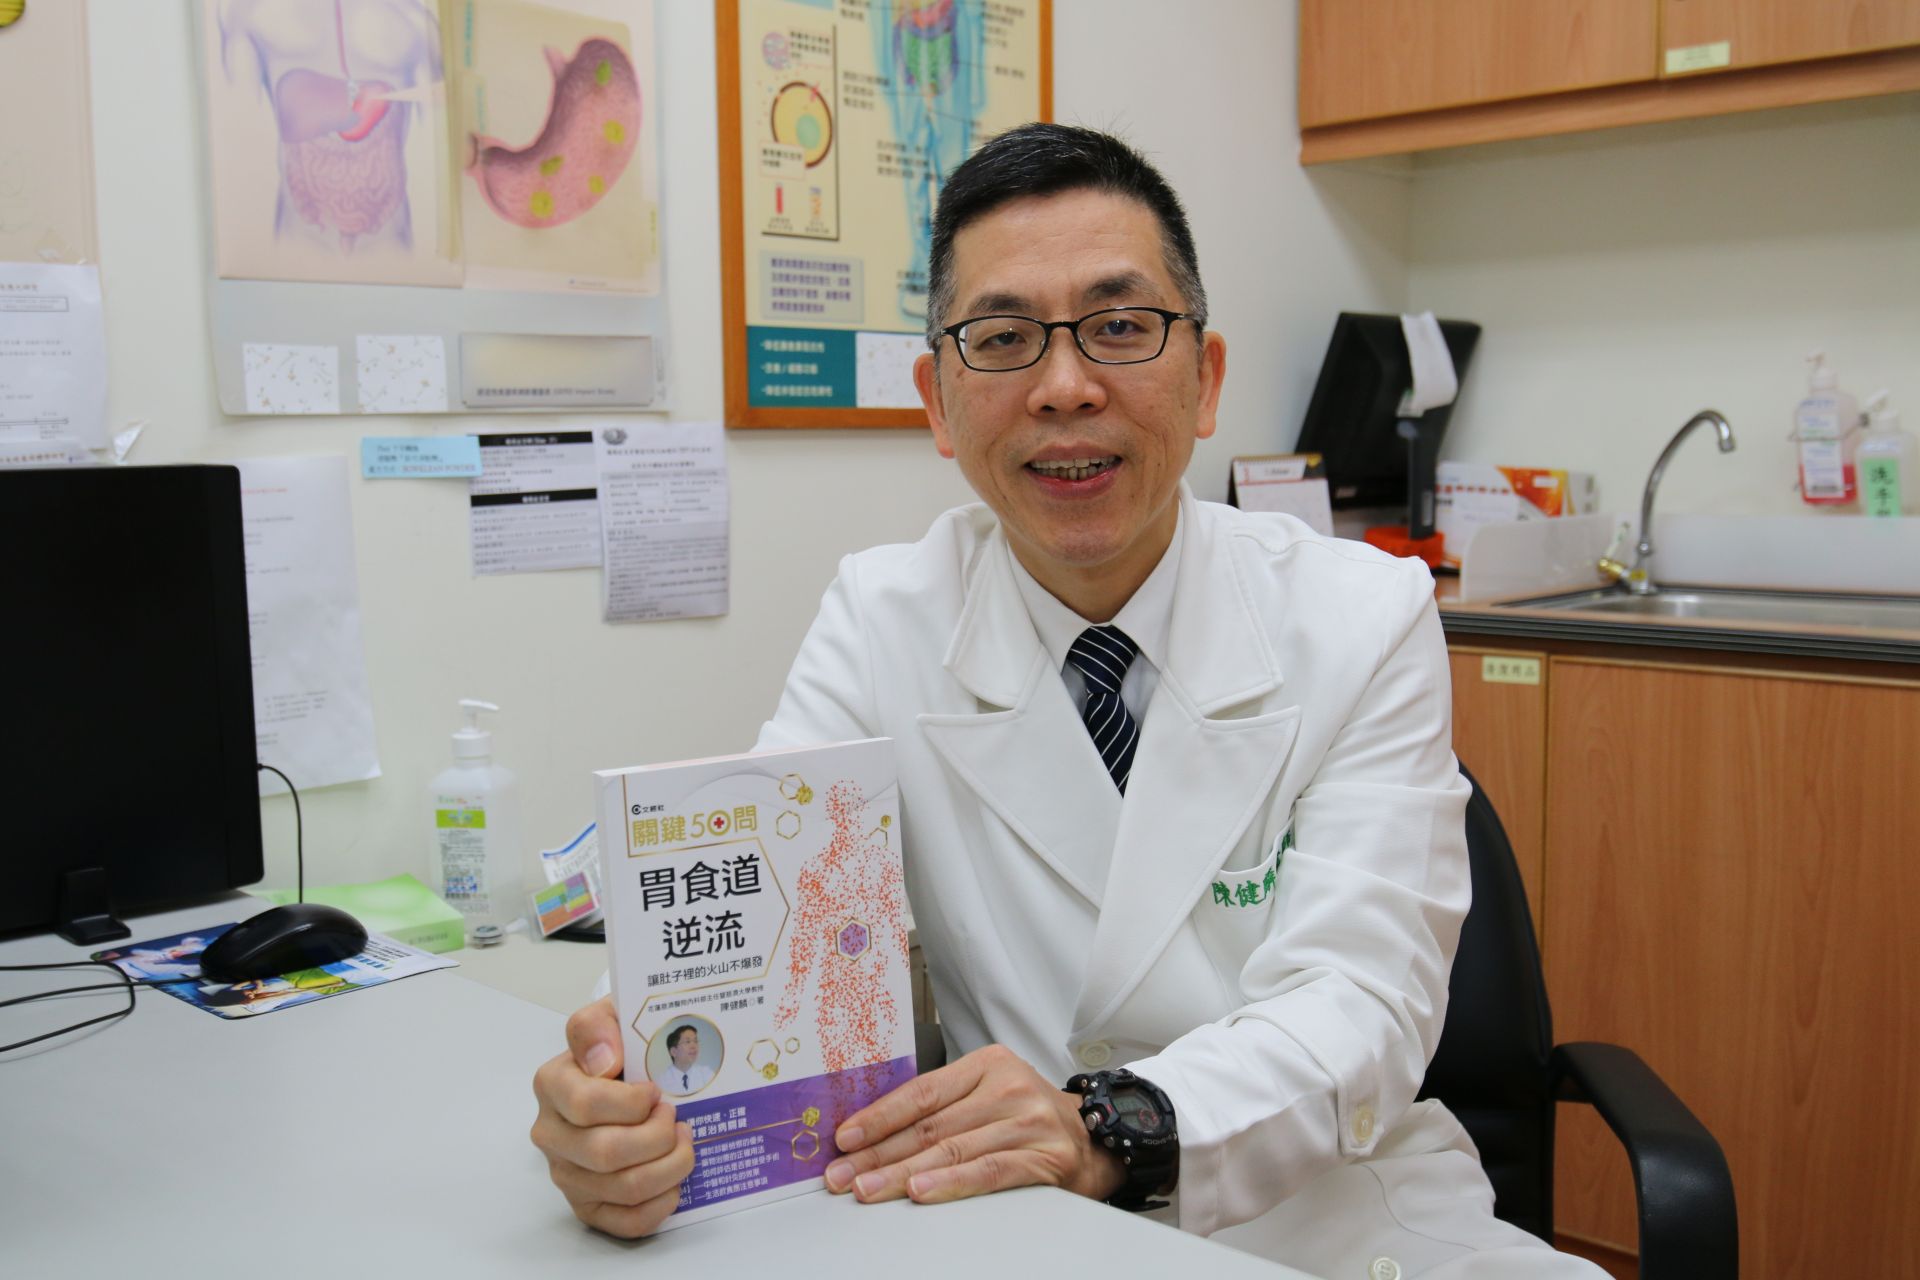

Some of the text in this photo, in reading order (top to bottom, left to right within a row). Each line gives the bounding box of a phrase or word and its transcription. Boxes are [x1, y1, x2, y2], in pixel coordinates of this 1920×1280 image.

[632, 804, 758, 847] 關鍵50問
[639, 853, 761, 912] 胃食道
[662, 910, 745, 961] 逆流
[647, 955, 763, 988] 讓肚子裡的火山不爆發
